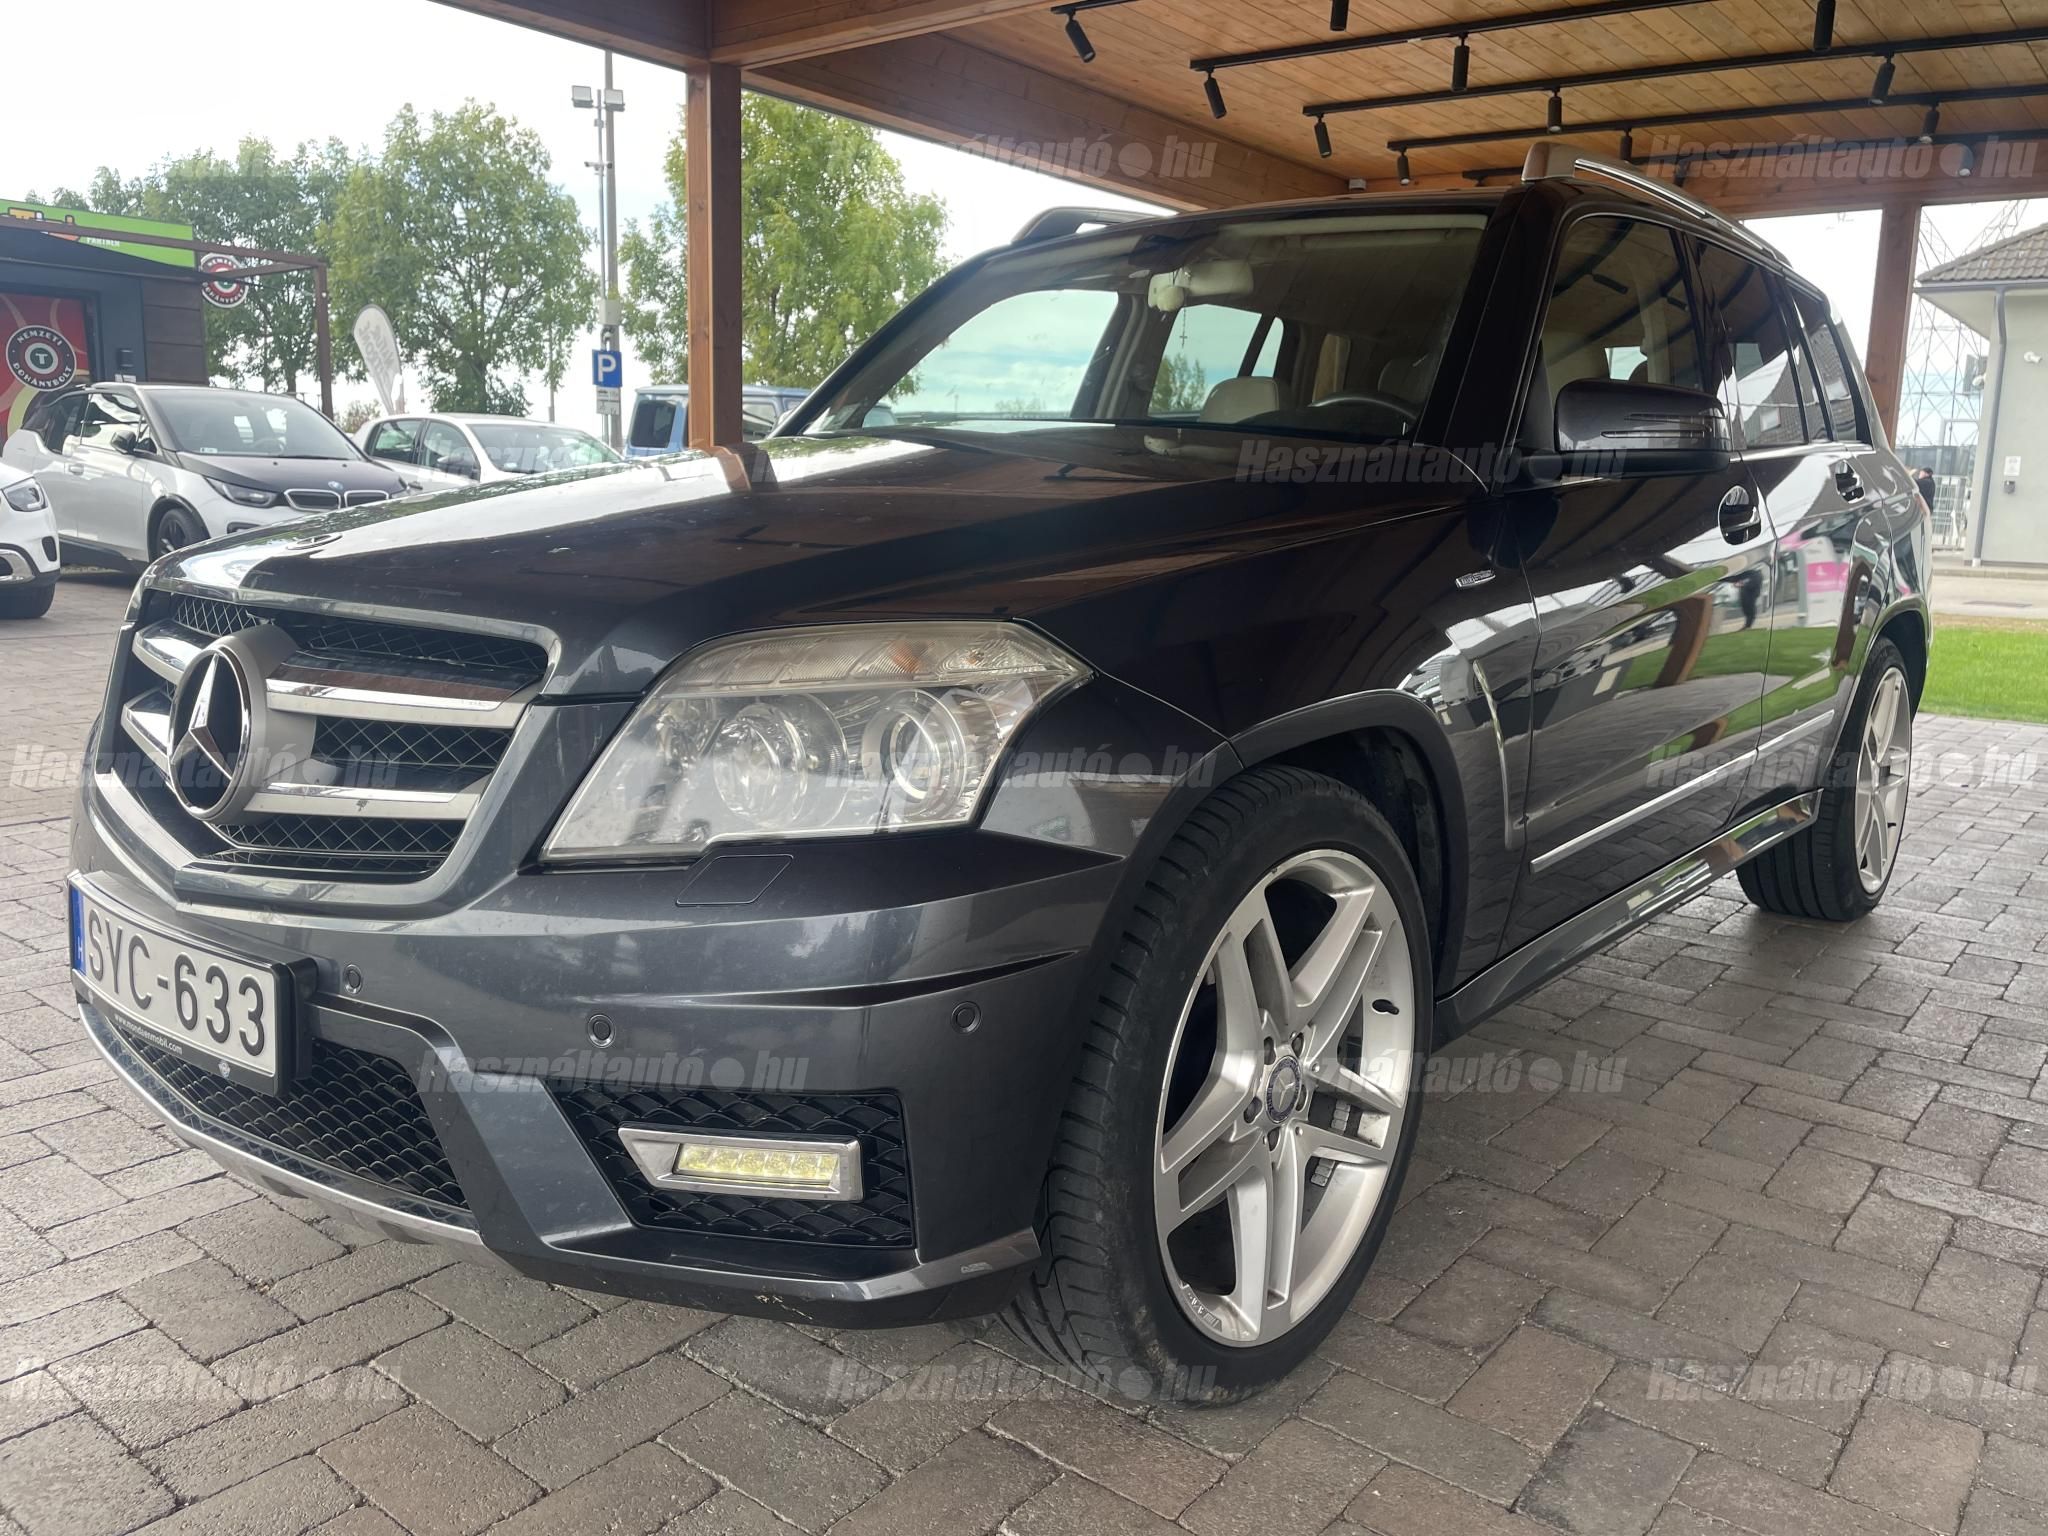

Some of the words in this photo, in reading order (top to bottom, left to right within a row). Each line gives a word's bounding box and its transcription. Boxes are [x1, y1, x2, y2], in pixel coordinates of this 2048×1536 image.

[17, 330, 62, 345] NEMZETI
[598, 354, 616, 382] P
[88, 908, 265, 1057] SYC-633
